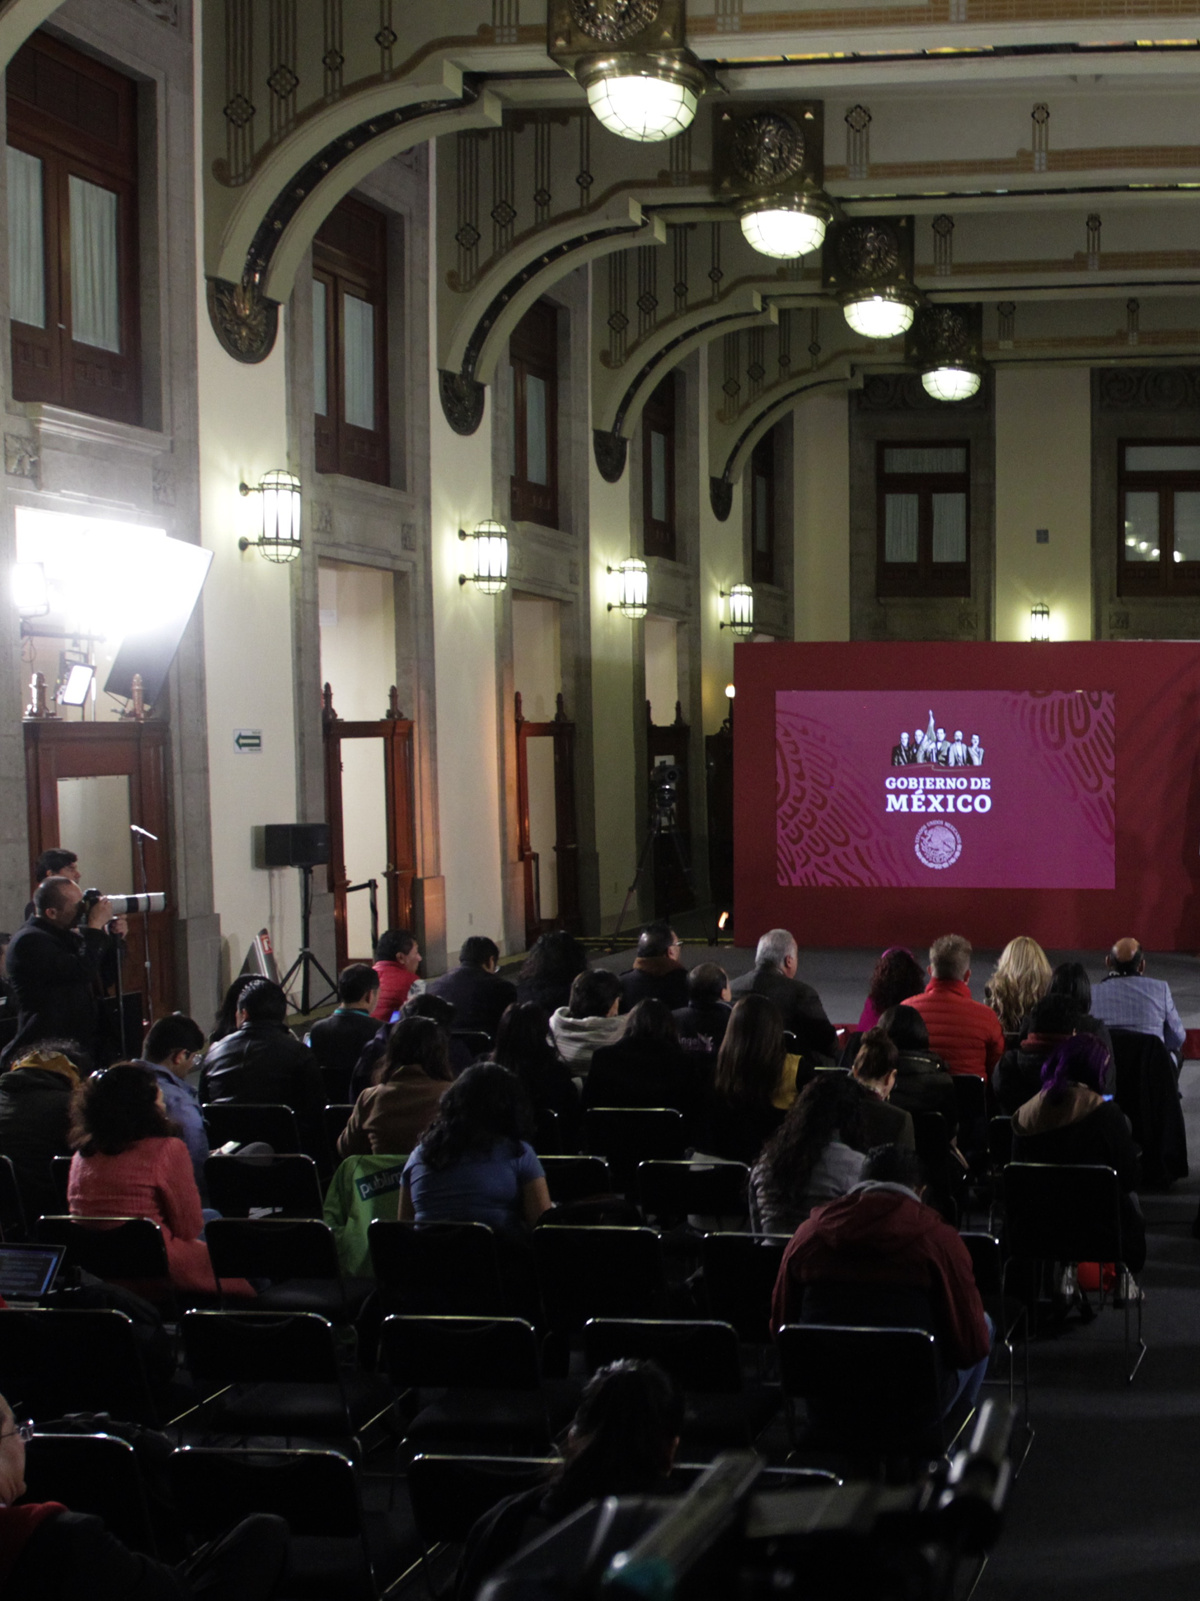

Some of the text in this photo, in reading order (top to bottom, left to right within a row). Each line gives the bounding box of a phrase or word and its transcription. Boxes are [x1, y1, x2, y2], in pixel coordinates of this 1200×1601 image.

[885, 776, 991, 790] GOBIERNO DE
[885, 788, 992, 813] MÉXICO
